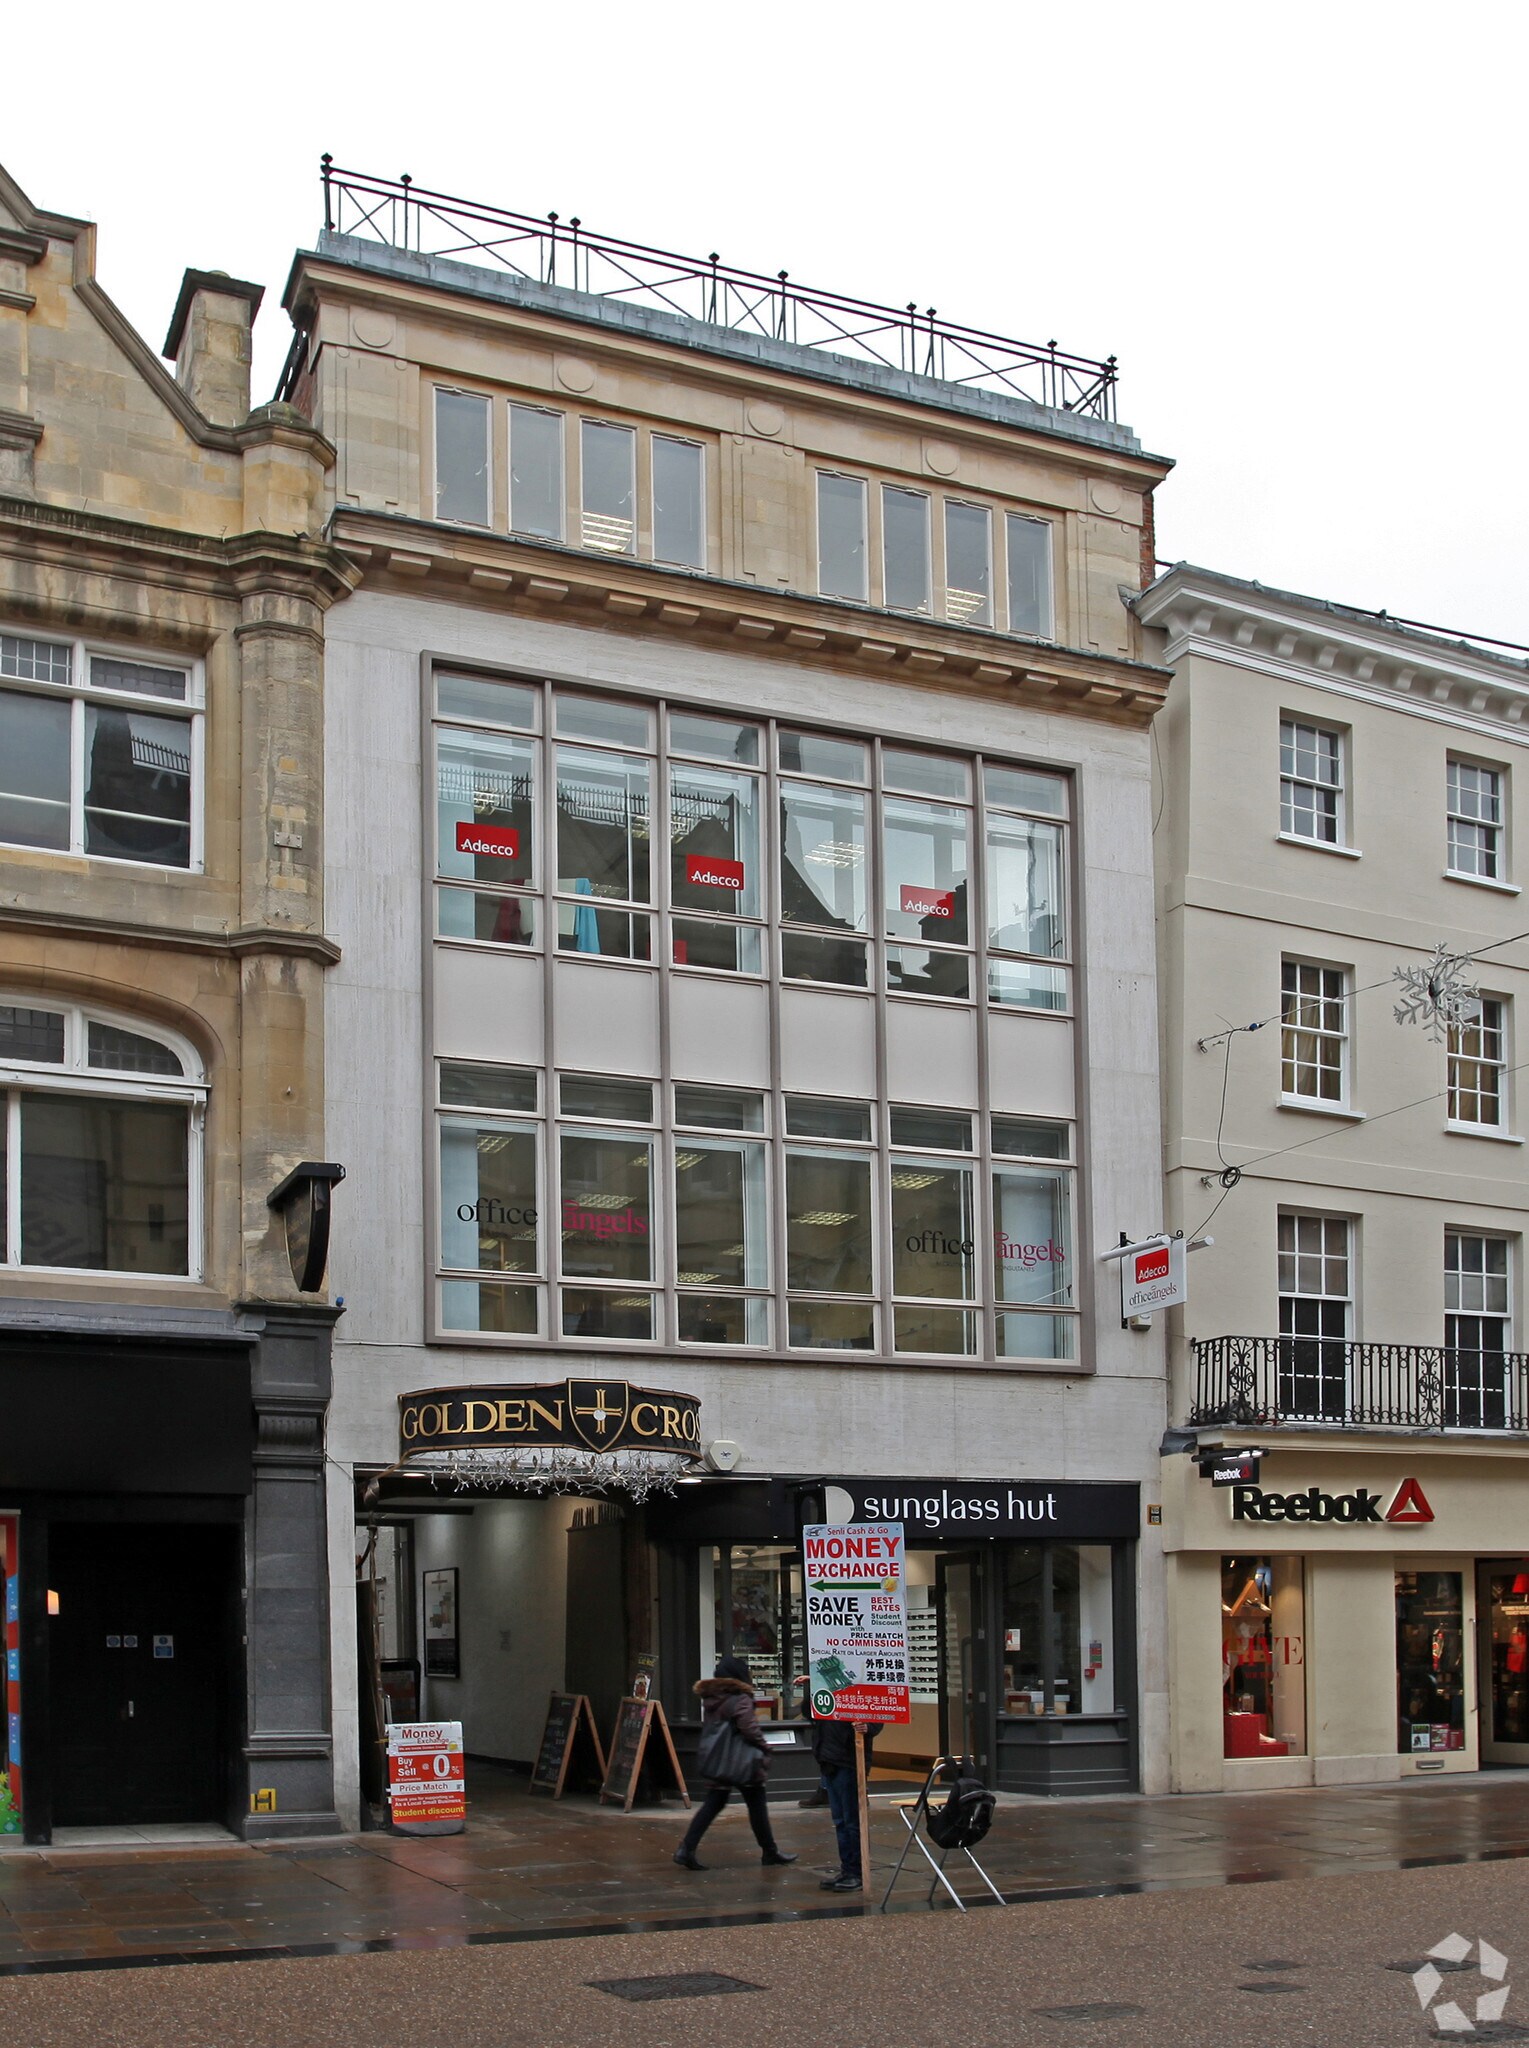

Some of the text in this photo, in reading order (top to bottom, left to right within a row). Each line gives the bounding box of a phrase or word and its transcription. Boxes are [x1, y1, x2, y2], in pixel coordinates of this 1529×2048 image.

[461, 840, 514, 856] Adecco
[692, 870, 740, 888] Adecco
[904, 900, 949, 916] Adecco
[457, 1197, 648, 1239] office angels
[906, 1230, 1065, 1266] office angels
[1138, 1265, 1167, 1280] Adecco
[1129, 1282, 1177, 1306] officeangels
[402, 1399, 566, 1440] GOLDEN
[1214, 1468, 1241, 1480] Reebok
[864, 1489, 1057, 1528] sunglass hut
[1232, 1486, 1384, 1522] Reebok
[827, 1528, 845, 1536] Senli
[877, 1526, 888, 1534] Go
[806, 1536, 900, 1559] MONEY
[808, 1562, 900, 1578] EXCHANGE
[808, 1597, 859, 1612] SAVE
[870, 1596, 894, 1604] BEST
[871, 1604, 900, 1612] RATES
[810, 1613, 864, 1626] MONEY
[842, 1639, 904, 1647] COMMISSION
[866, 1658, 904, 1670] 外币兑换
[866, 1671, 905, 1683] 无手续费
[817, 1695, 830, 1706] 80
[870, 1704, 906, 1712] Currencies
[402, 1729, 442, 1738] Money
[398, 1757, 413, 1766] Buy
[398, 1768, 416, 1776] Sell
[255, 1792, 272, 1810] H
[393, 1806, 464, 1817] Student discount
